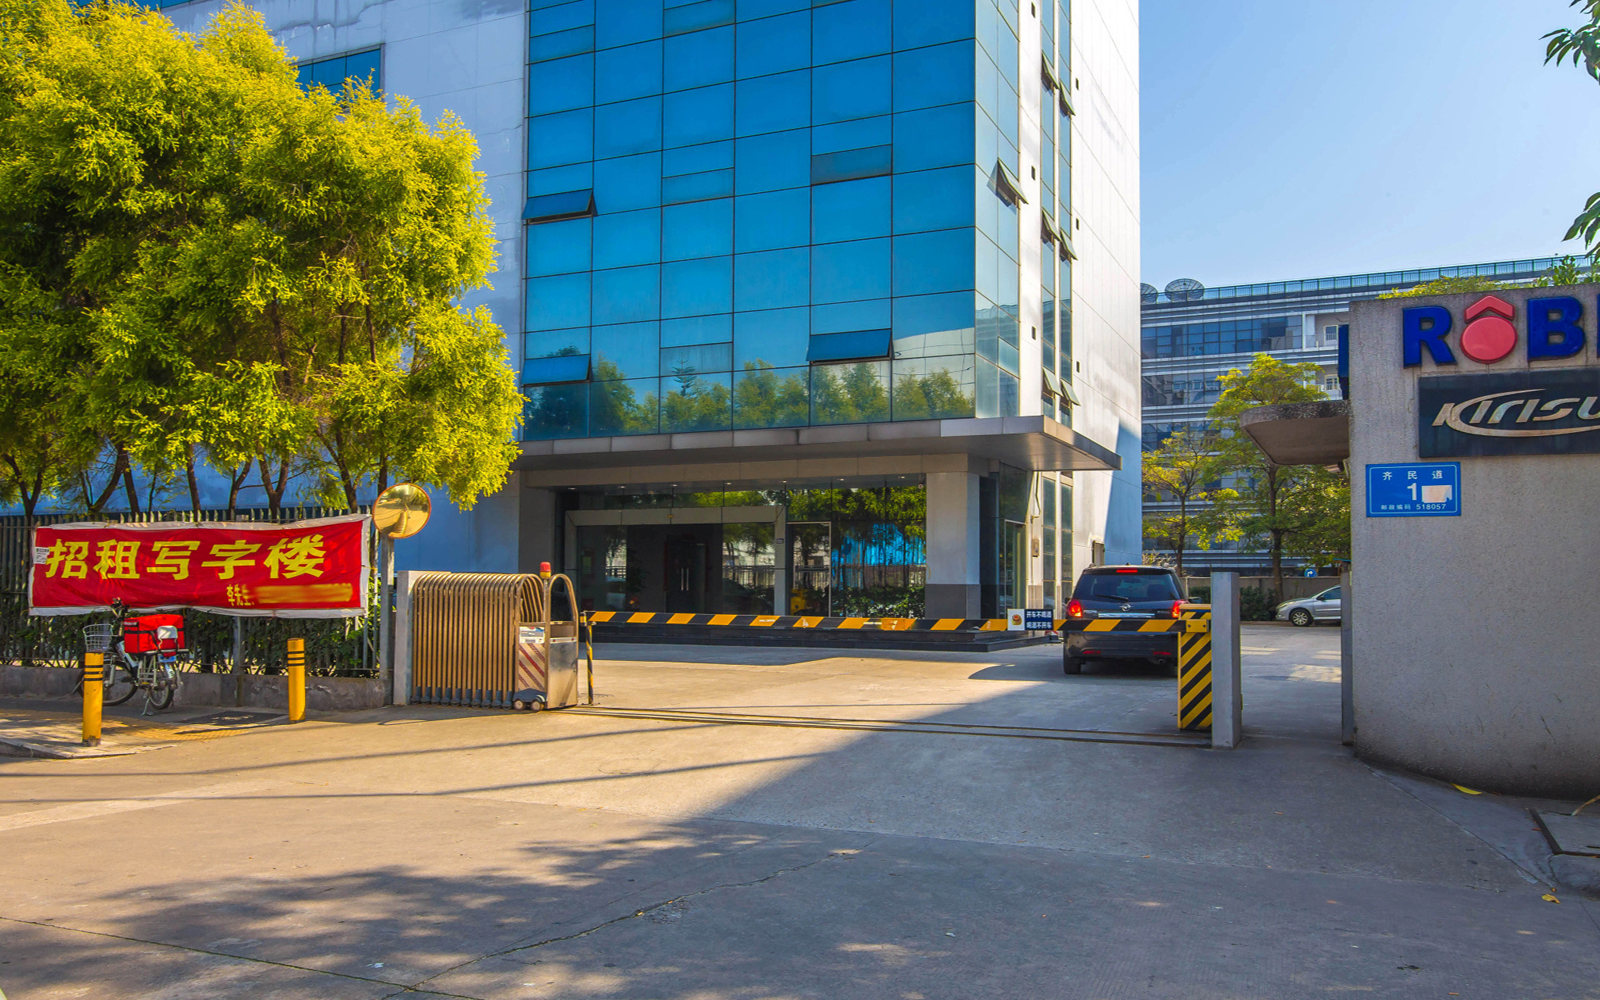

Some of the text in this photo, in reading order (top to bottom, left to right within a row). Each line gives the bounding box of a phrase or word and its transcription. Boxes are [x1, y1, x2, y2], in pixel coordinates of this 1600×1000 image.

[1382, 470, 1443, 480] 齐民道
[45, 534, 327, 580] 招租写字楼
